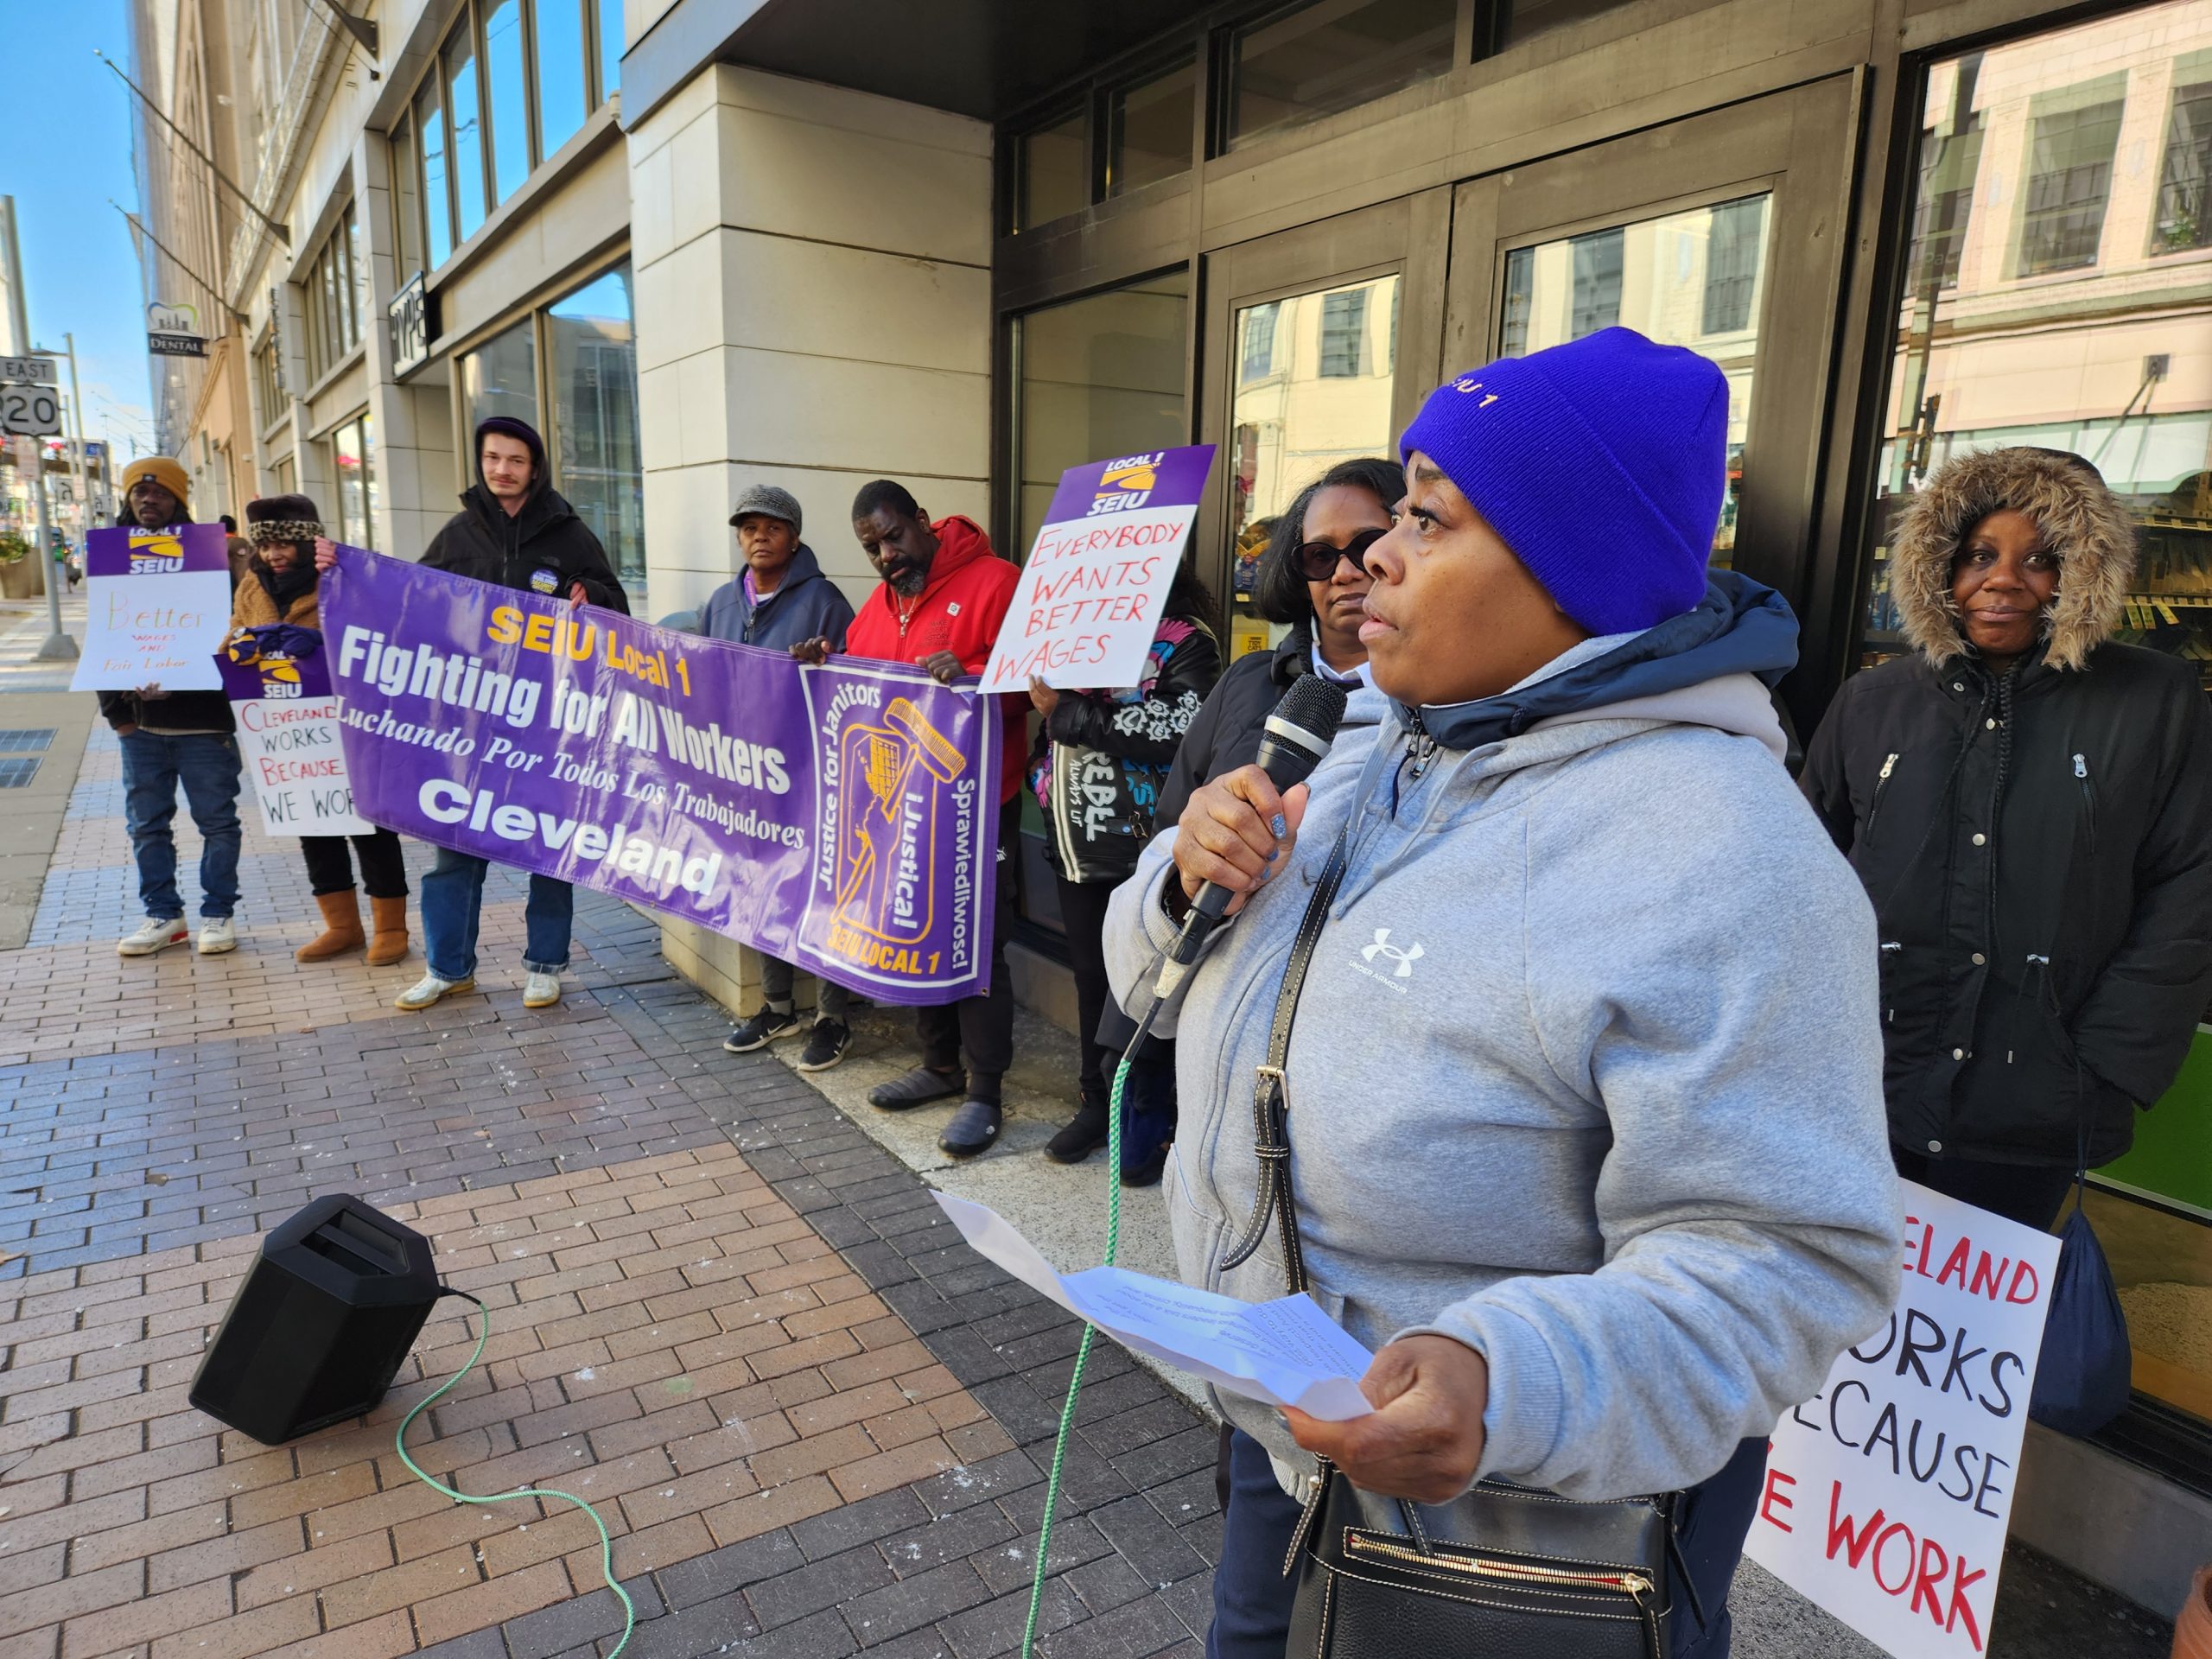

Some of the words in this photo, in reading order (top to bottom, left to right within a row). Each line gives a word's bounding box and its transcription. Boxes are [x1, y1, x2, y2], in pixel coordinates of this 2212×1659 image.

[150, 338, 200, 353] DENTAL
[5, 362, 48, 378] EAST
[6, 395, 56, 424] 20
[1479, 394, 1498, 409] 1
[1105, 454, 1151, 473] LOCAL
[1154, 451, 1165, 463] 1
[1086, 490, 1151, 518] SEIU
[130, 527, 171, 537] LOCAL
[1031, 522, 1184, 569] EVERYBODY
[130, 557, 184, 575] SEIU
[1032, 556, 1161, 606] WANTS
[108, 590, 207, 631] Better
[1025, 594, 1148, 638] BETTER
[132, 633, 176, 643] WAGES
[138, 644, 167, 652] AND
[486, 605, 595, 662] SEIU
[607, 629, 670, 690] Local
[675, 657, 691, 696] 1
[104, 659, 134, 672] Fair
[144, 657, 190, 670] Labor
[992, 634, 1111, 686] WAGES
[264, 683, 302, 699] SEIU
[338, 624, 543, 729] Fighting
[549, 677, 610, 740] for
[612, 690, 659, 755] All
[659, 704, 791, 796] Workers
[241, 702, 337, 733] CLEVELAND
[822, 682, 882, 748] Janitors
[261, 727, 333, 754] WORKS
[259, 756, 345, 787] BECAUSE
[336, 695, 475, 759] Luchando
[480, 736, 543, 774] Por
[550, 750, 622, 795] Todos
[622, 771, 669, 807] Los
[671, 781, 806, 851] Trabajadores
[823, 747, 840, 788] for
[1069, 759, 1083, 806] ALWAYS
[263, 791, 301, 824] WE
[417, 778, 723, 897] Cleveland
[817, 795, 838, 892] Justice
[950, 778, 976, 970] Sprawiedliwosc!
[827, 924, 860, 958] SEIU
[858, 942, 924, 975] LOCAL
[928, 950, 942, 975] 1
[1348, 960, 1374, 976] UNDER
[1372, 974, 1408, 994] ARMOUR
[1901, 1216, 2039, 1306] ELAND
[1847, 1308, 2025, 1419] ORKS
[1792, 1380, 2010, 1519] ECAUSE
[1761, 1468, 1797, 1534] E
[1826, 1480, 1986, 1652] WORK
